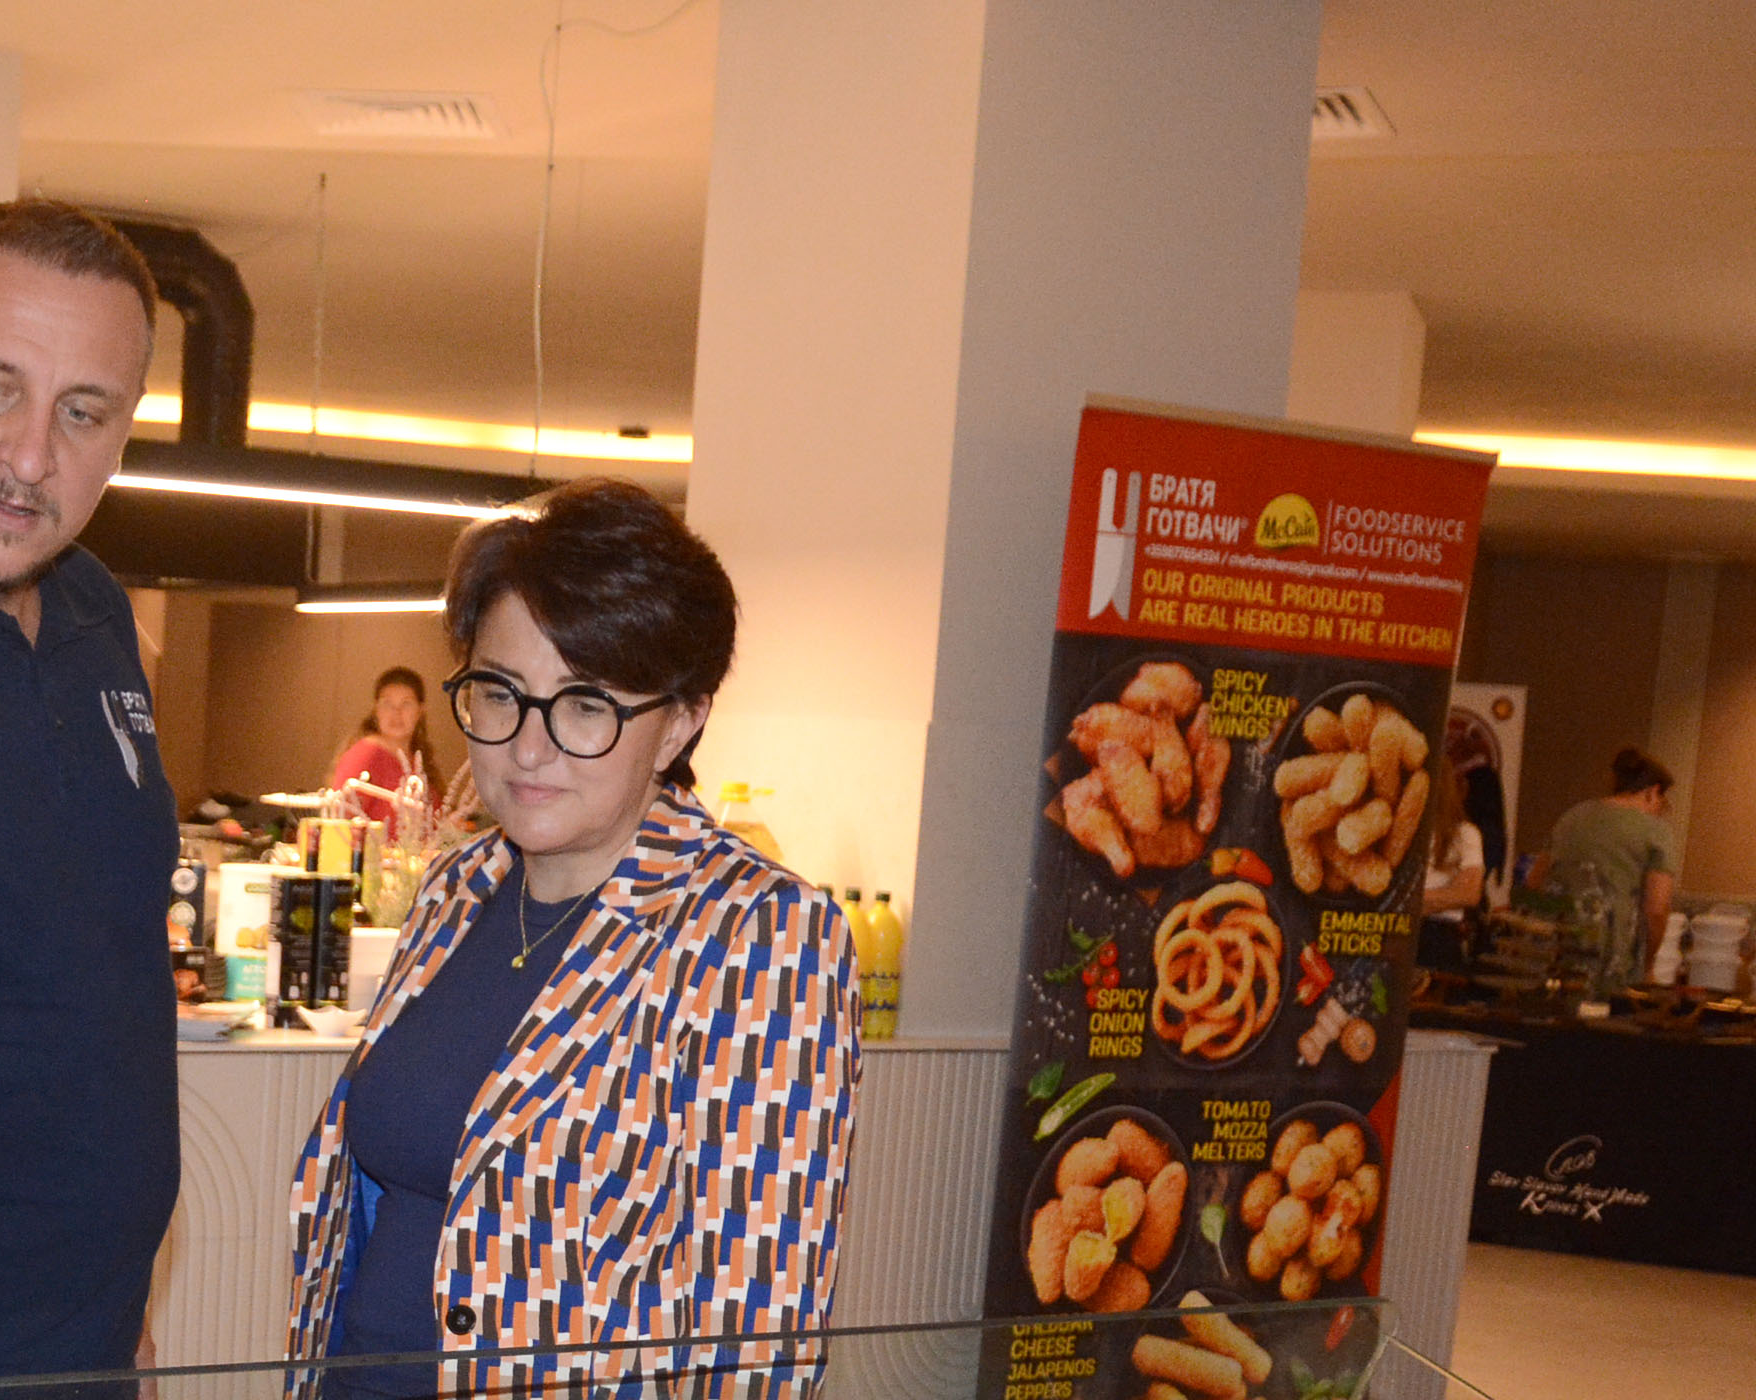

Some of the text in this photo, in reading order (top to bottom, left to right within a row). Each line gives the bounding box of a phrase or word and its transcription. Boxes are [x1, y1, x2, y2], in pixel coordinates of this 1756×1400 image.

[1149, 473, 1216, 508] БРАТЯ
[1334, 505, 1466, 543] FOODSERVICE
[1331, 532, 1444, 565] SOLUTIONS
[1145, 568, 1384, 616] OUR ORIGINAL PRODUCTS
[1139, 599, 1453, 649] ARE REAL HEROES IN THE KITCHEN
[1212, 668, 1268, 693] SPICY
[1210, 691, 1290, 716] CHICKEN
[1208, 714, 1271, 738] WINGS
[1319, 910, 1411, 935] EMMENTAL
[1317, 931, 1382, 954] STICKS
[1095, 988, 1149, 1009] SPICY
[1089, 1011, 1145, 1034] ONION
[1088, 1035, 1143, 1058] RINGS
[1202, 1099, 1272, 1120] TOMATO
[1212, 1120, 1269, 1140] MOZZA
[1192, 1140, 1266, 1161] MELTERS
[1010, 1336, 1076, 1360] CHEESE
[1007, 1358, 1096, 1382] JALAPENOS
[1005, 1381, 1072, 1400] PEPPERS
